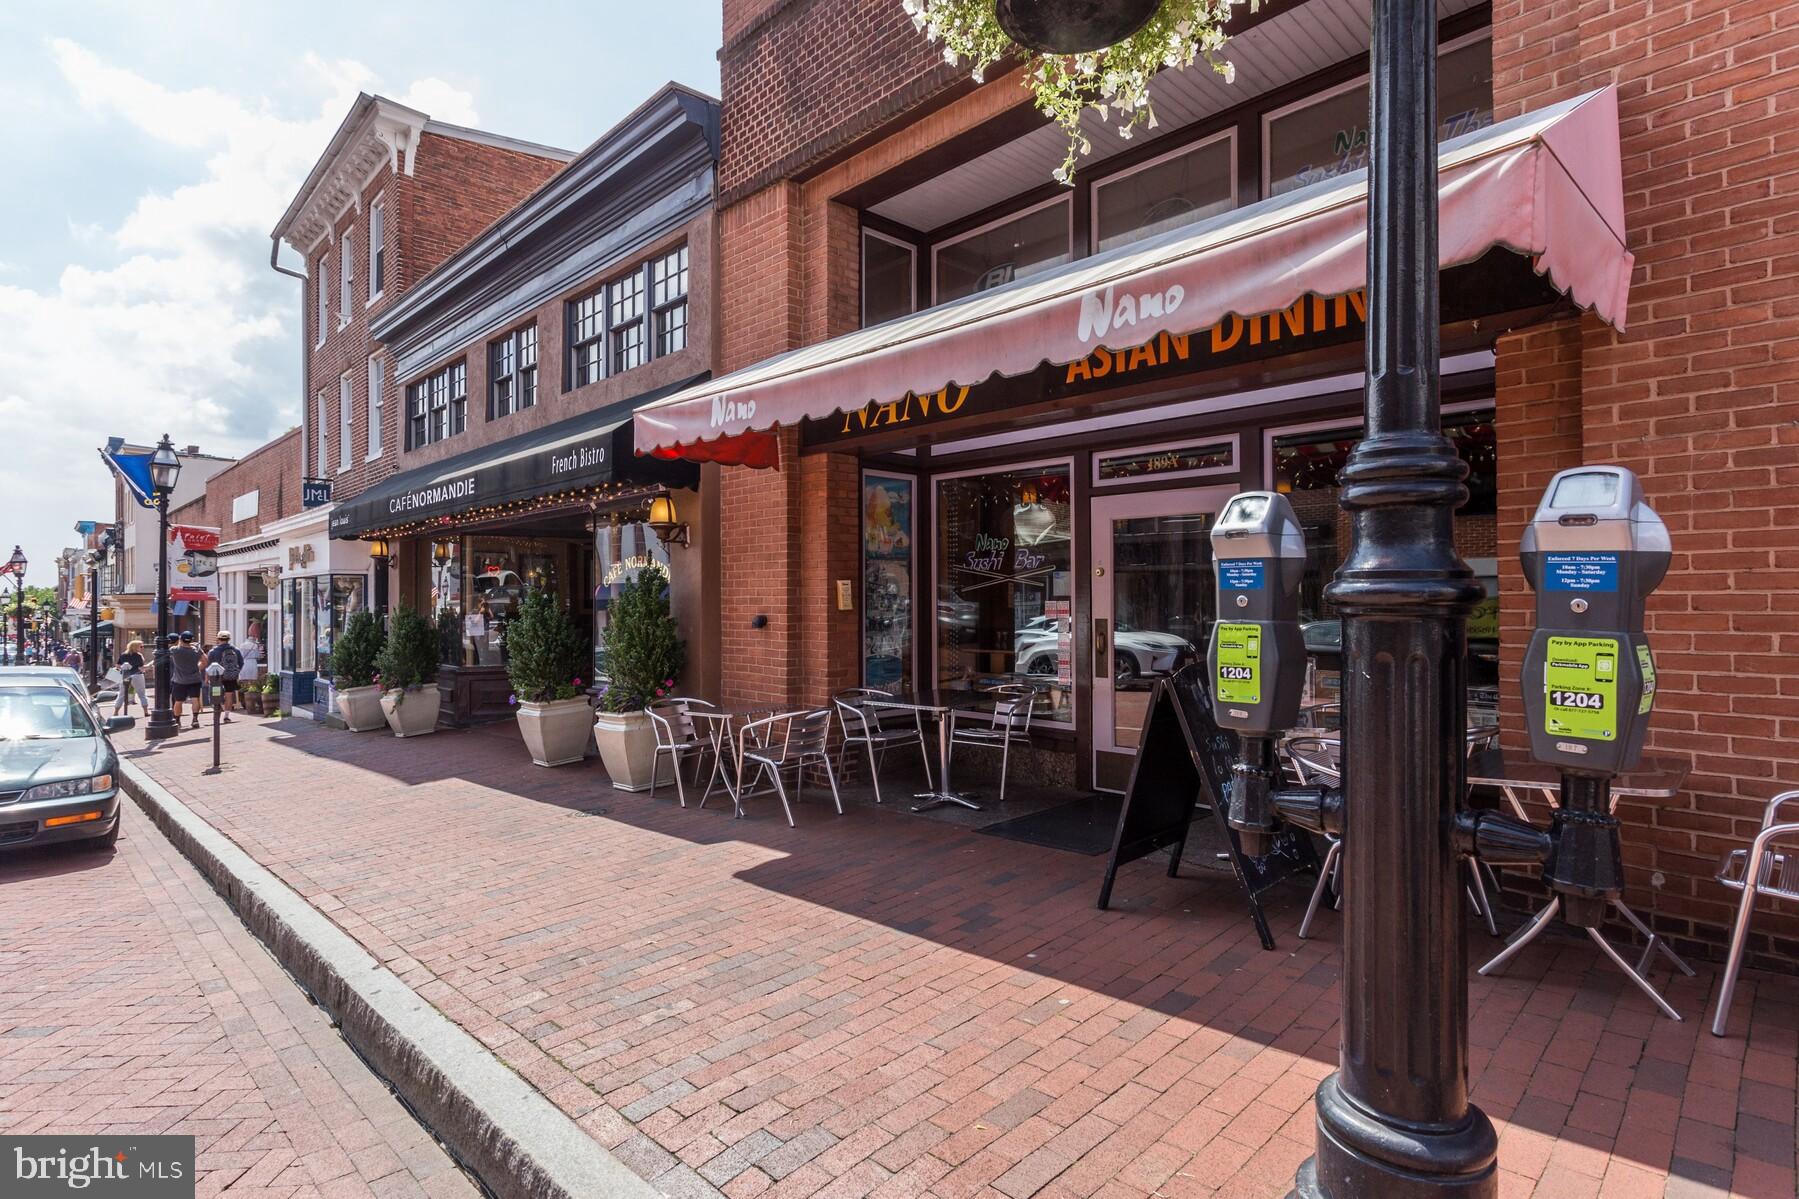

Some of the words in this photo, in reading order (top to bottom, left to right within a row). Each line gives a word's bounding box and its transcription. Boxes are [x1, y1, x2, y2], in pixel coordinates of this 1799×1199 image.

[1077, 284, 1185, 343] Nano
[710, 395, 756, 428] Nano
[551, 449, 577, 475] French
[580, 447, 605, 468] Bistro
[975, 533, 1009, 551] Nano
[963, 550, 1005, 571] Sushi
[1014, 548, 1045, 569] Bar
[1221, 667, 1251, 680] 1204
[1552, 691, 1601, 709] 1204
